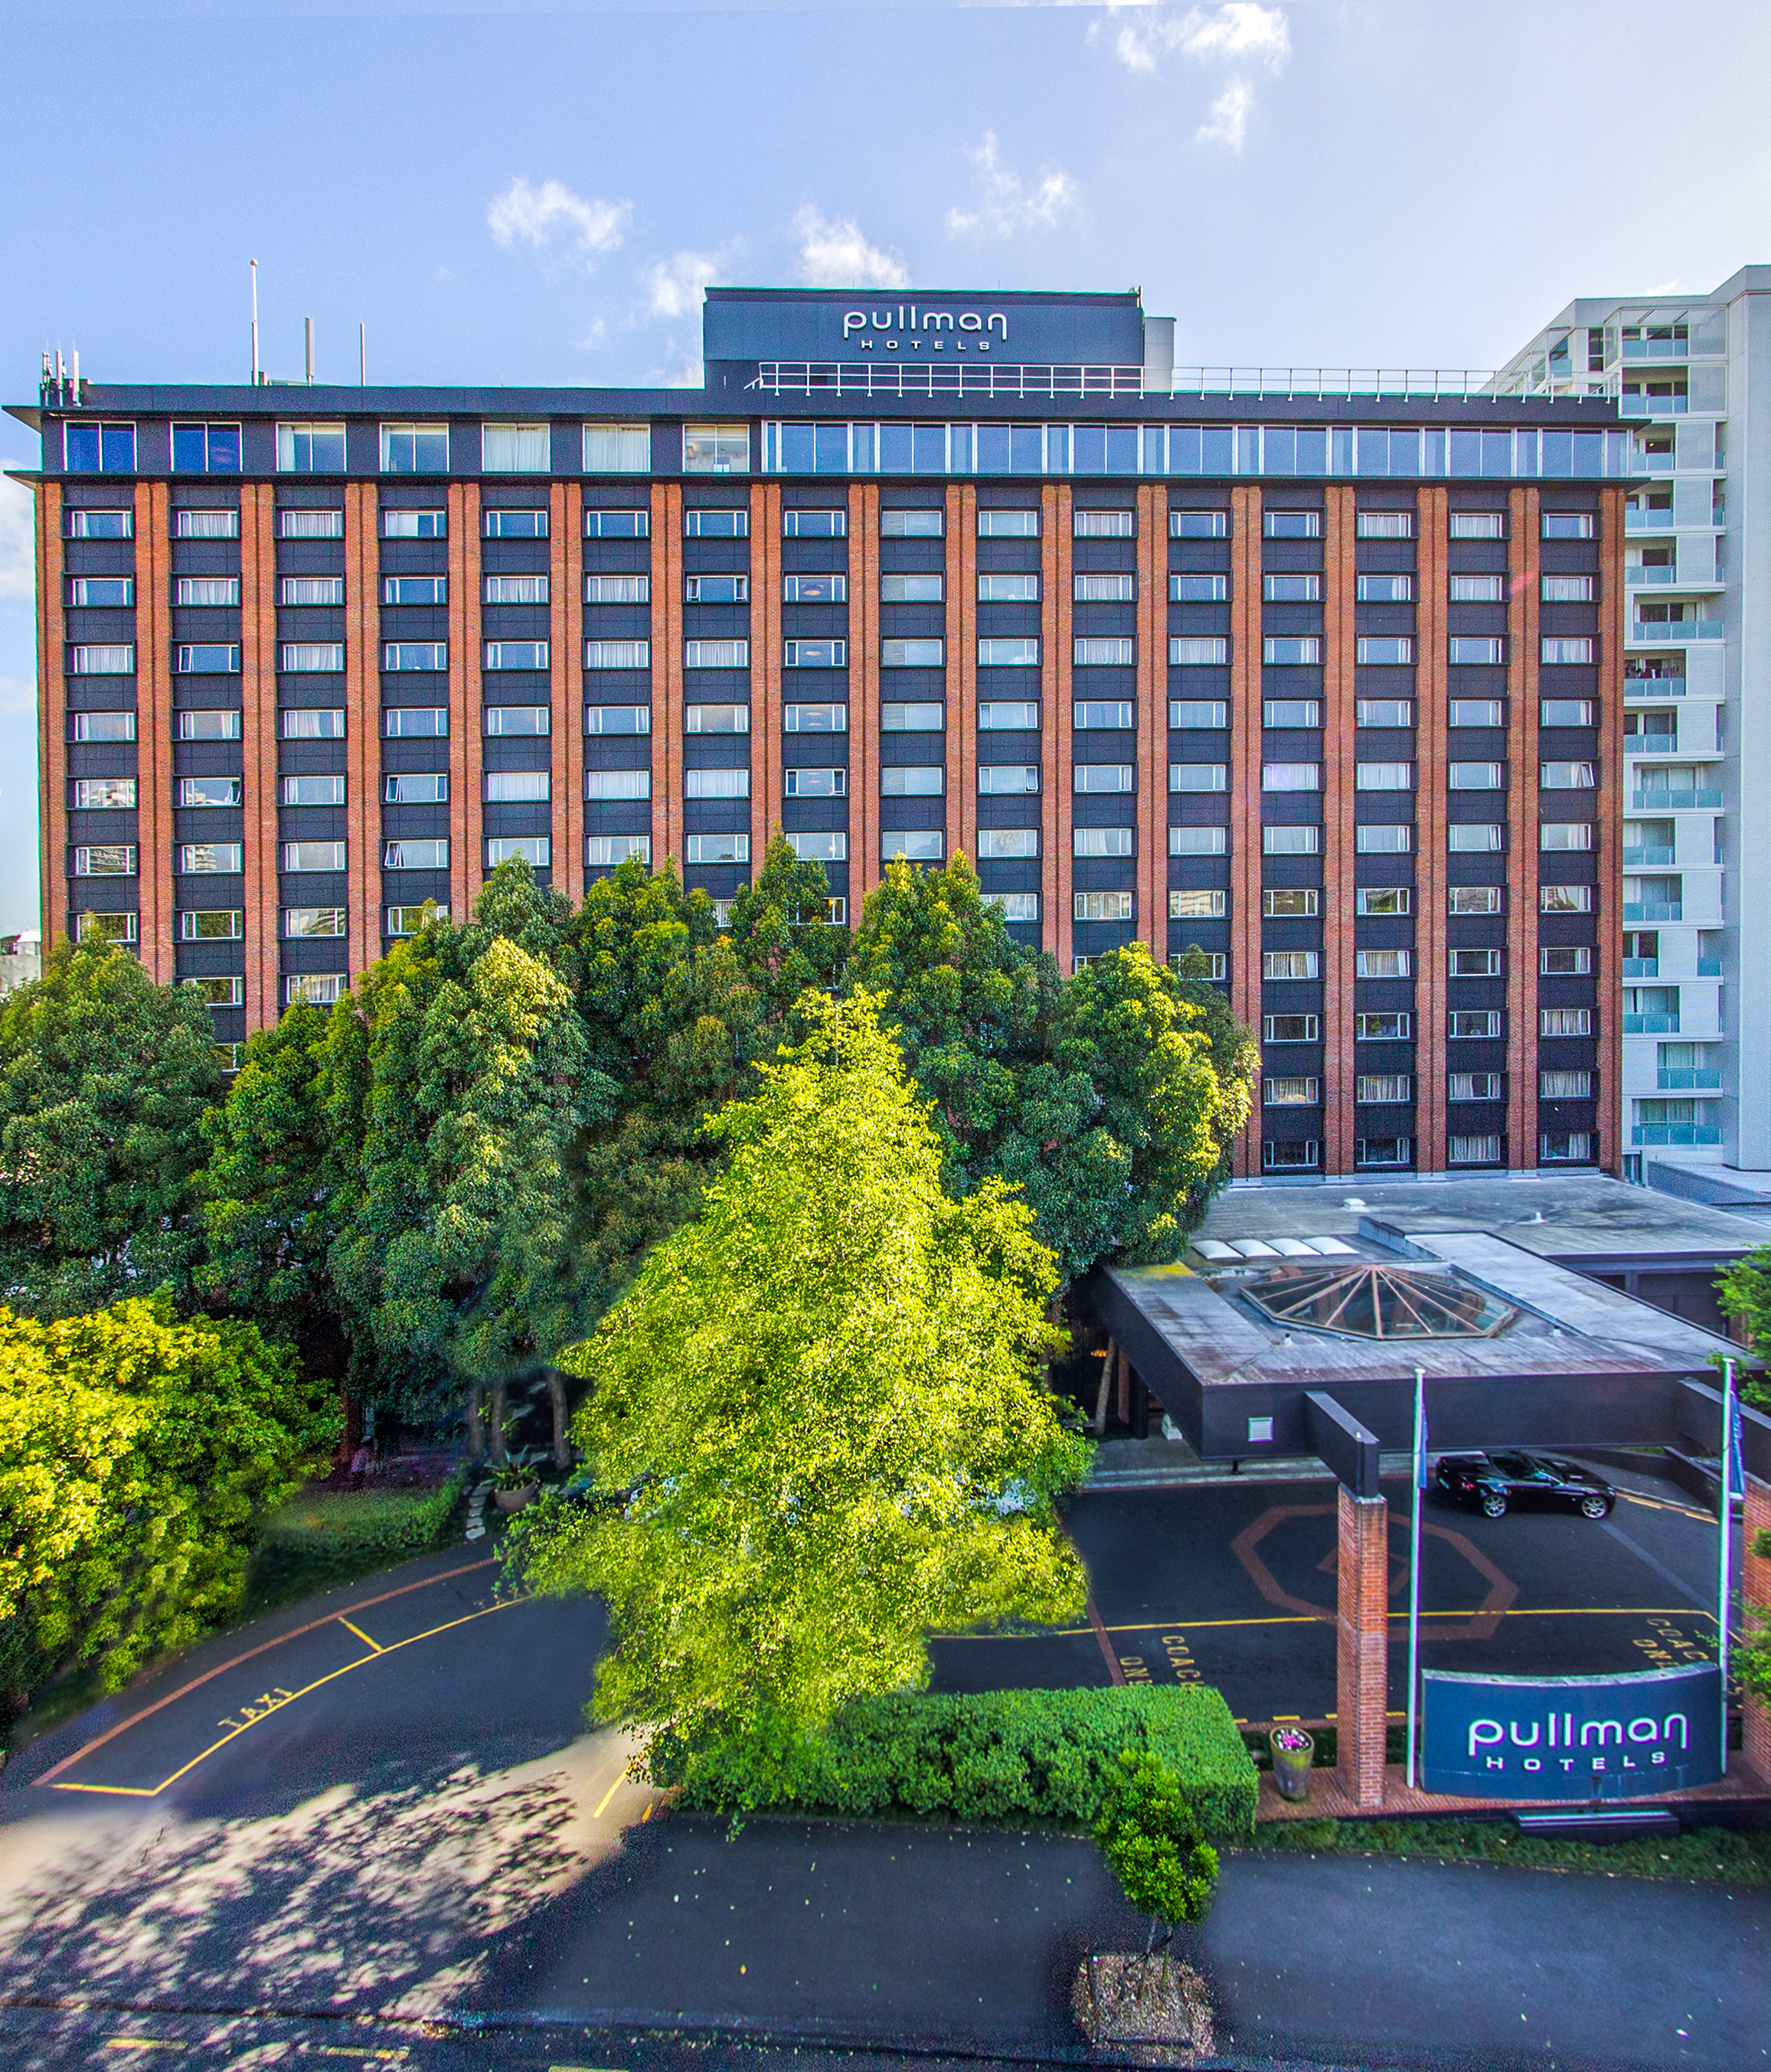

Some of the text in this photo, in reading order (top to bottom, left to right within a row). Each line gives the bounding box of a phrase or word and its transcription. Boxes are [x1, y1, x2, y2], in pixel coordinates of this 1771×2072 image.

[843, 305, 1008, 341] pullman
[861, 339, 991, 351] HOTELS
[217, 1687, 293, 1728] TAXI
[1467, 1711, 1691, 1758] pullman
[1485, 1750, 1667, 1772] HOTELS
